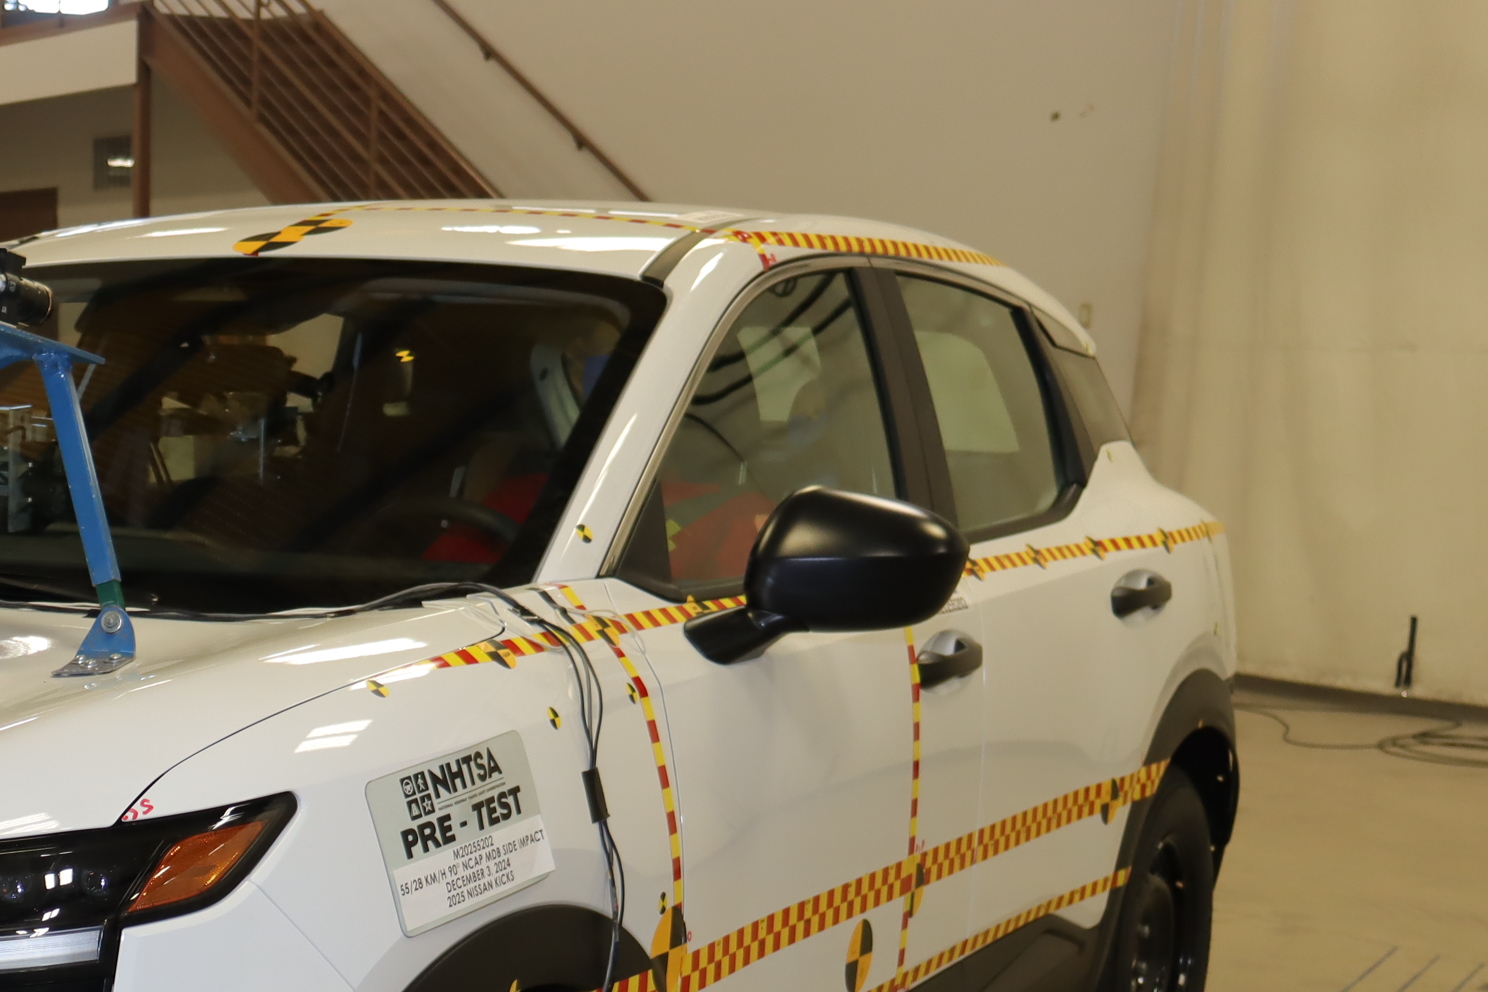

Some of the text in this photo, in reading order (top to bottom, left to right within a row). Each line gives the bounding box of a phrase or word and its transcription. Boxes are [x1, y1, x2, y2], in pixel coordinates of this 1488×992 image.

[427, 747, 502, 799] NHTSA
[400, 813, 456, 860] PRE
[471, 785, 521, 831] TEST
[400, 877, 423, 896] 55/28
[424, 868, 447, 887] KM/H
[462, 854, 483, 872] NCAP
[485, 847, 501, 863] MDB
[502, 840, 517, 856] SIDE
[518, 829, 545, 849] IMPACT
[453, 835, 494, 860] M20255202
[446, 868, 485, 893] DECEMBER
[494, 857, 511, 873] 2024
[447, 870, 515, 908] 2025 NISSAN KICKS
